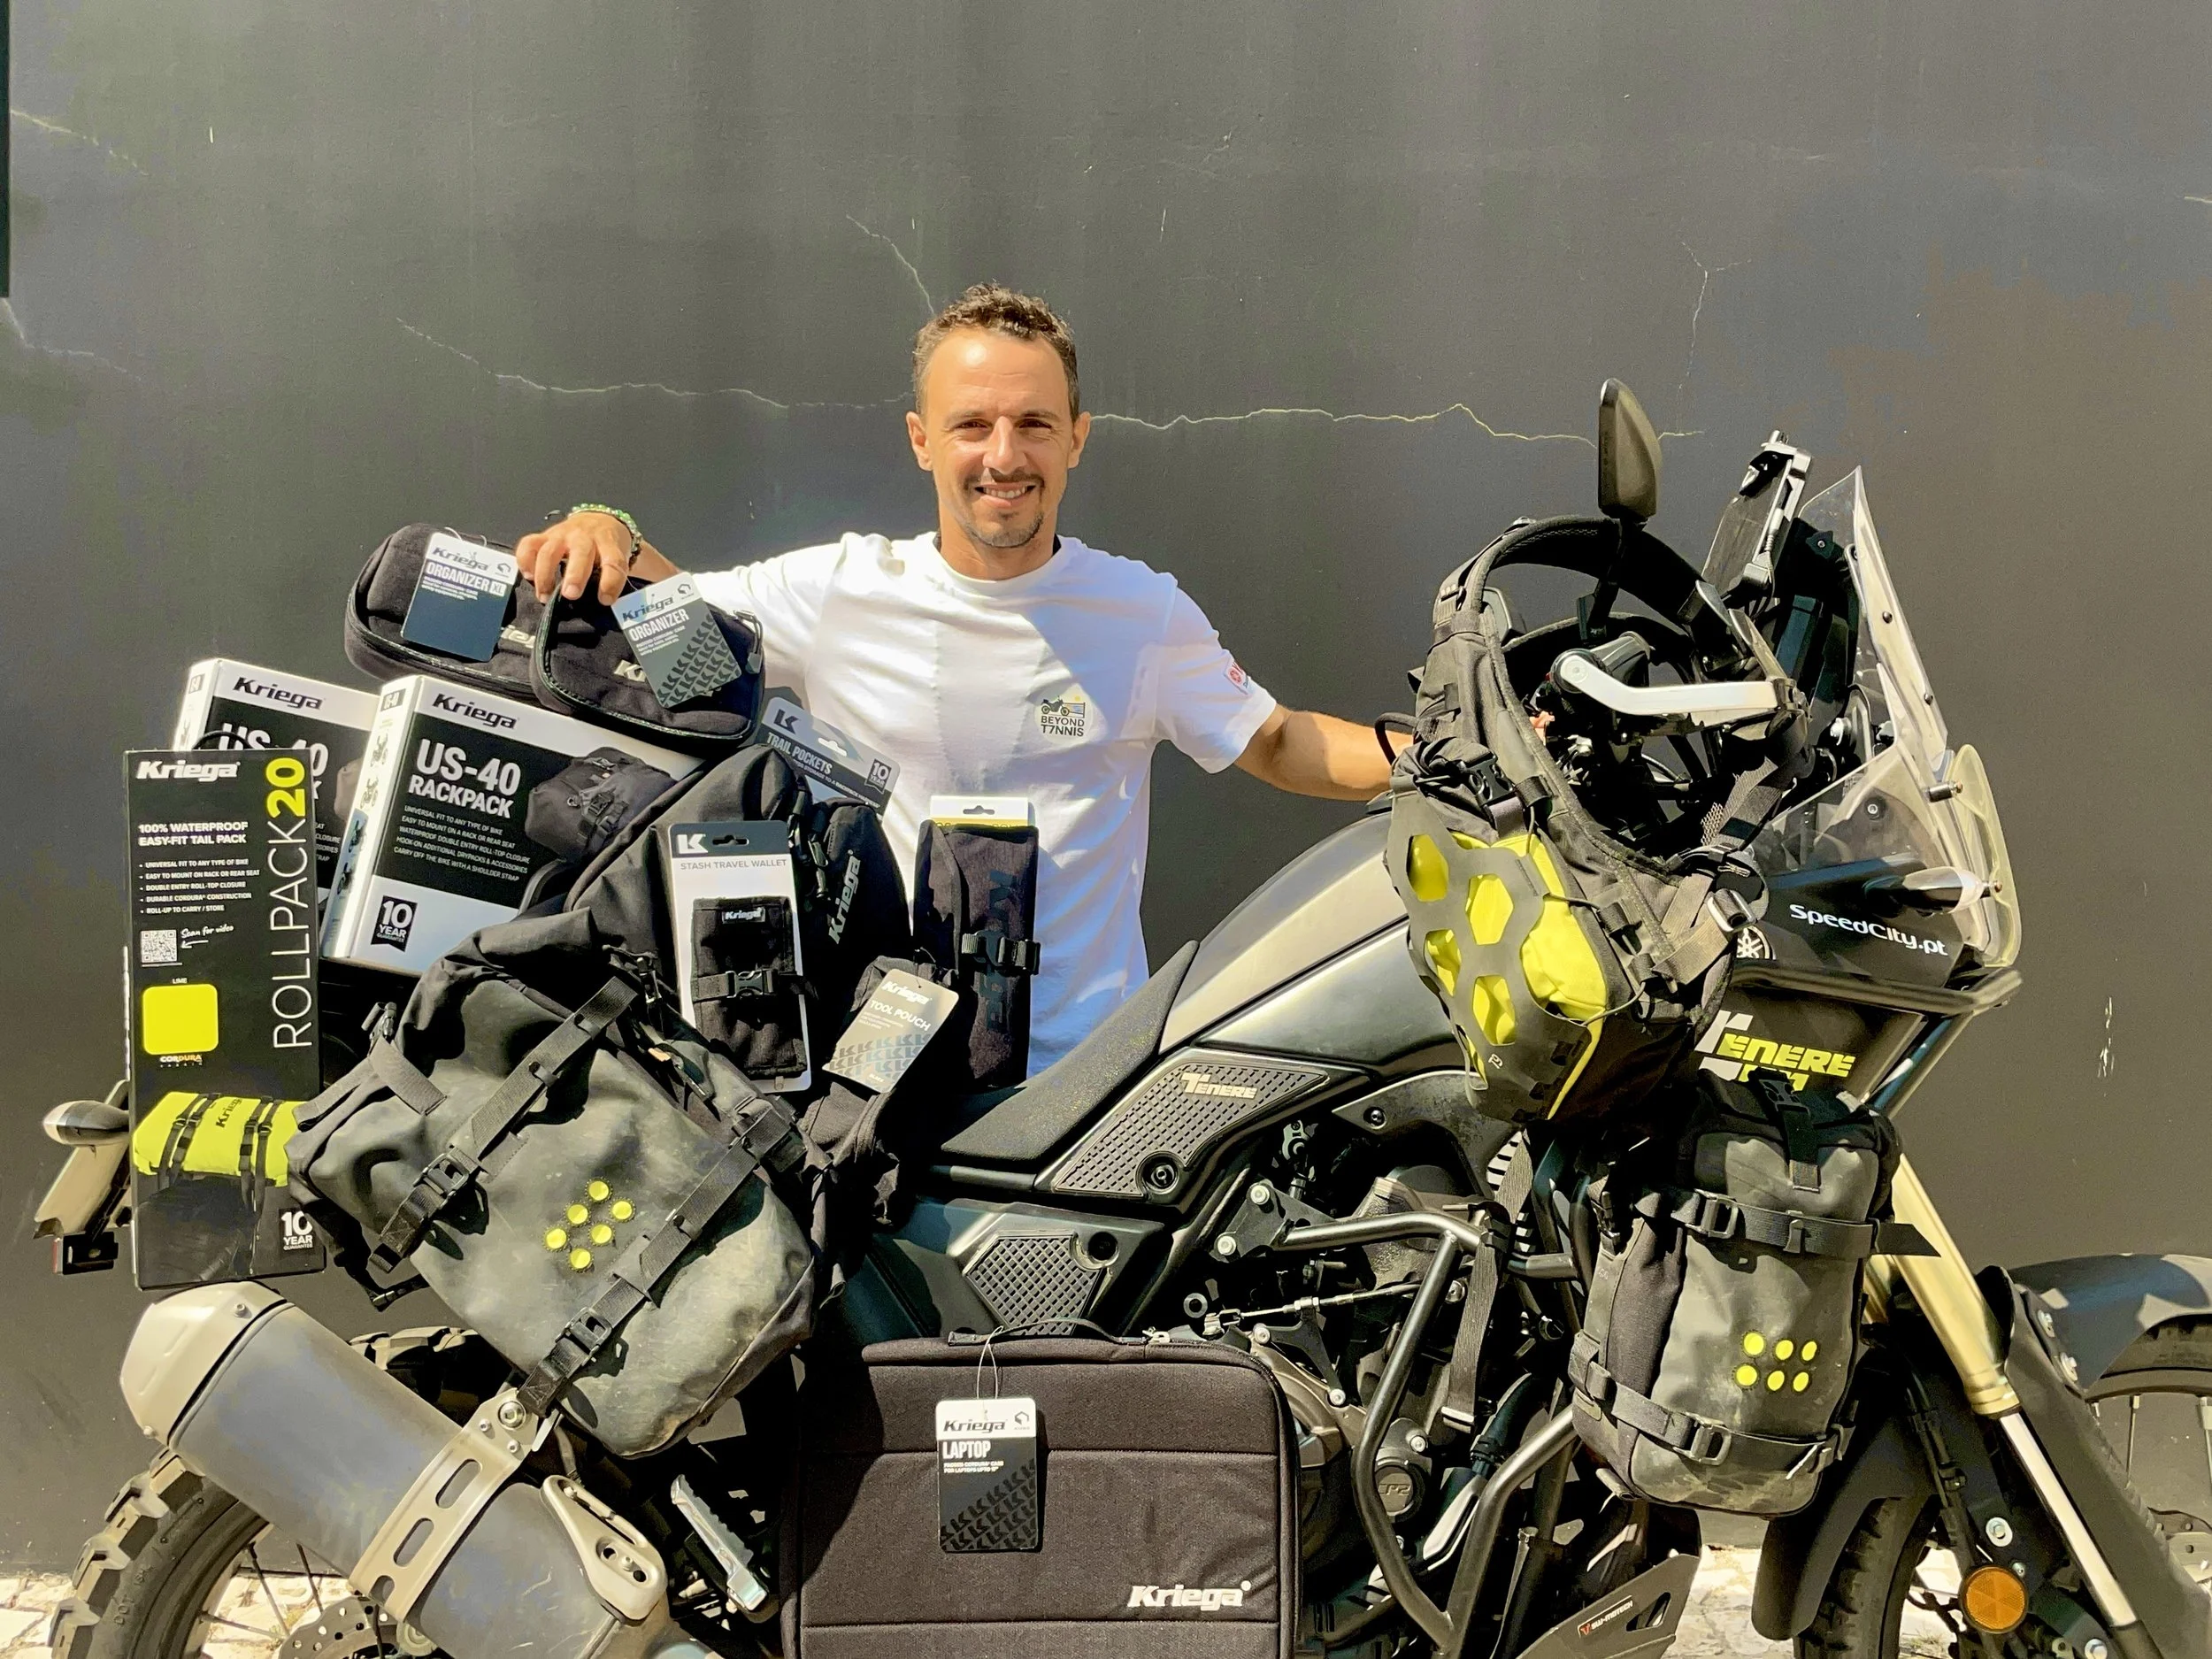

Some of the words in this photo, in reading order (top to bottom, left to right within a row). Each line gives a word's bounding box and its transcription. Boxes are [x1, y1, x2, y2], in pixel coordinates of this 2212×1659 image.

[433, 548, 489, 571] Kriega
[426, 562, 490, 591] ORGANIZER
[622, 595, 673, 621] Kriega
[628, 608, 689, 641] ORGANIZER
[233, 676, 323, 710] Kriega
[432, 693, 518, 730] Kriega
[1041, 715, 1085, 727] BEYOND
[1041, 724, 1085, 737] T7NNIS
[416, 738, 521, 796] US-40
[766, 733, 791, 755] TRAIL
[792, 746, 833, 774] POCKETS
[136, 759, 240, 782] Kriega
[870, 774, 885, 786] YEAR
[873, 762, 889, 780] 10
[265, 757, 306, 818] 20
[408, 774, 514, 818] RACKPACK
[138, 824, 168, 833] 100%
[169, 821, 249, 833] WATERPROOF
[402, 816, 417, 825] EASY
[426, 821, 447, 832] MOUNT
[462, 830, 477, 840] RACK
[487, 836, 501, 845] REAR
[502, 840, 516, 849] SEAT
[404, 805, 435, 818] UNIVERSAL
[455, 818, 466, 827] ANY
[468, 821, 482, 831] TYPE
[490, 826, 503, 835] BIKE
[138, 836, 188, 847] EASY-FIT
[190, 835, 214, 844] TAIL
[216, 834, 247, 843] PACK
[399, 826, 437, 840] WATERPROOF
[438, 834, 459, 847] DOUBLE
[460, 840, 480, 850] ENTRY
[480, 844, 505, 856] ROLL-TOP
[506, 852, 531, 864] CLOSURE
[394, 847, 413, 856] CARRY
[438, 857, 451, 866] BIKE
[451, 861, 466, 870] WITH
[472, 865, 501, 878] SHOULDER
[501, 872, 519, 881] STRAP
[423, 842, 457, 856] ADDITIONAL
[457, 851, 486, 864] DRYPACKS
[491, 859, 528, 874] ACCESSORIES
[680, 861, 711, 870] STASH
[714, 860, 749, 869] TRAVEL
[751, 859, 787, 868] WALLET
[207, 892, 252, 901] CONSTRUCTION
[828, 849, 862, 945] Kriega
[382, 900, 413, 928] 10
[180, 927, 201, 939] Scan
[203, 926, 215, 936] for
[216, 923, 234, 933] video
[267, 818, 312, 1048] ROLLPACK
[379, 924, 406, 938] YEAR
[1789, 903, 1948, 956] SpeedCity.pt
[880, 980, 932, 1005] Kriega
[870, 1000, 893, 1015] TOOL
[894, 1009, 931, 1031] POUCH
[281, 1210, 313, 1236] 10
[283, 1235, 313, 1246] YEAR
[943, 1418, 1006, 1434] Kriega
[942, 1440, 991, 1459] LAPTOP
[1127, 1581, 1248, 1611] Kriega
[1591, 1600, 1633, 1630] SW-MOTECH
